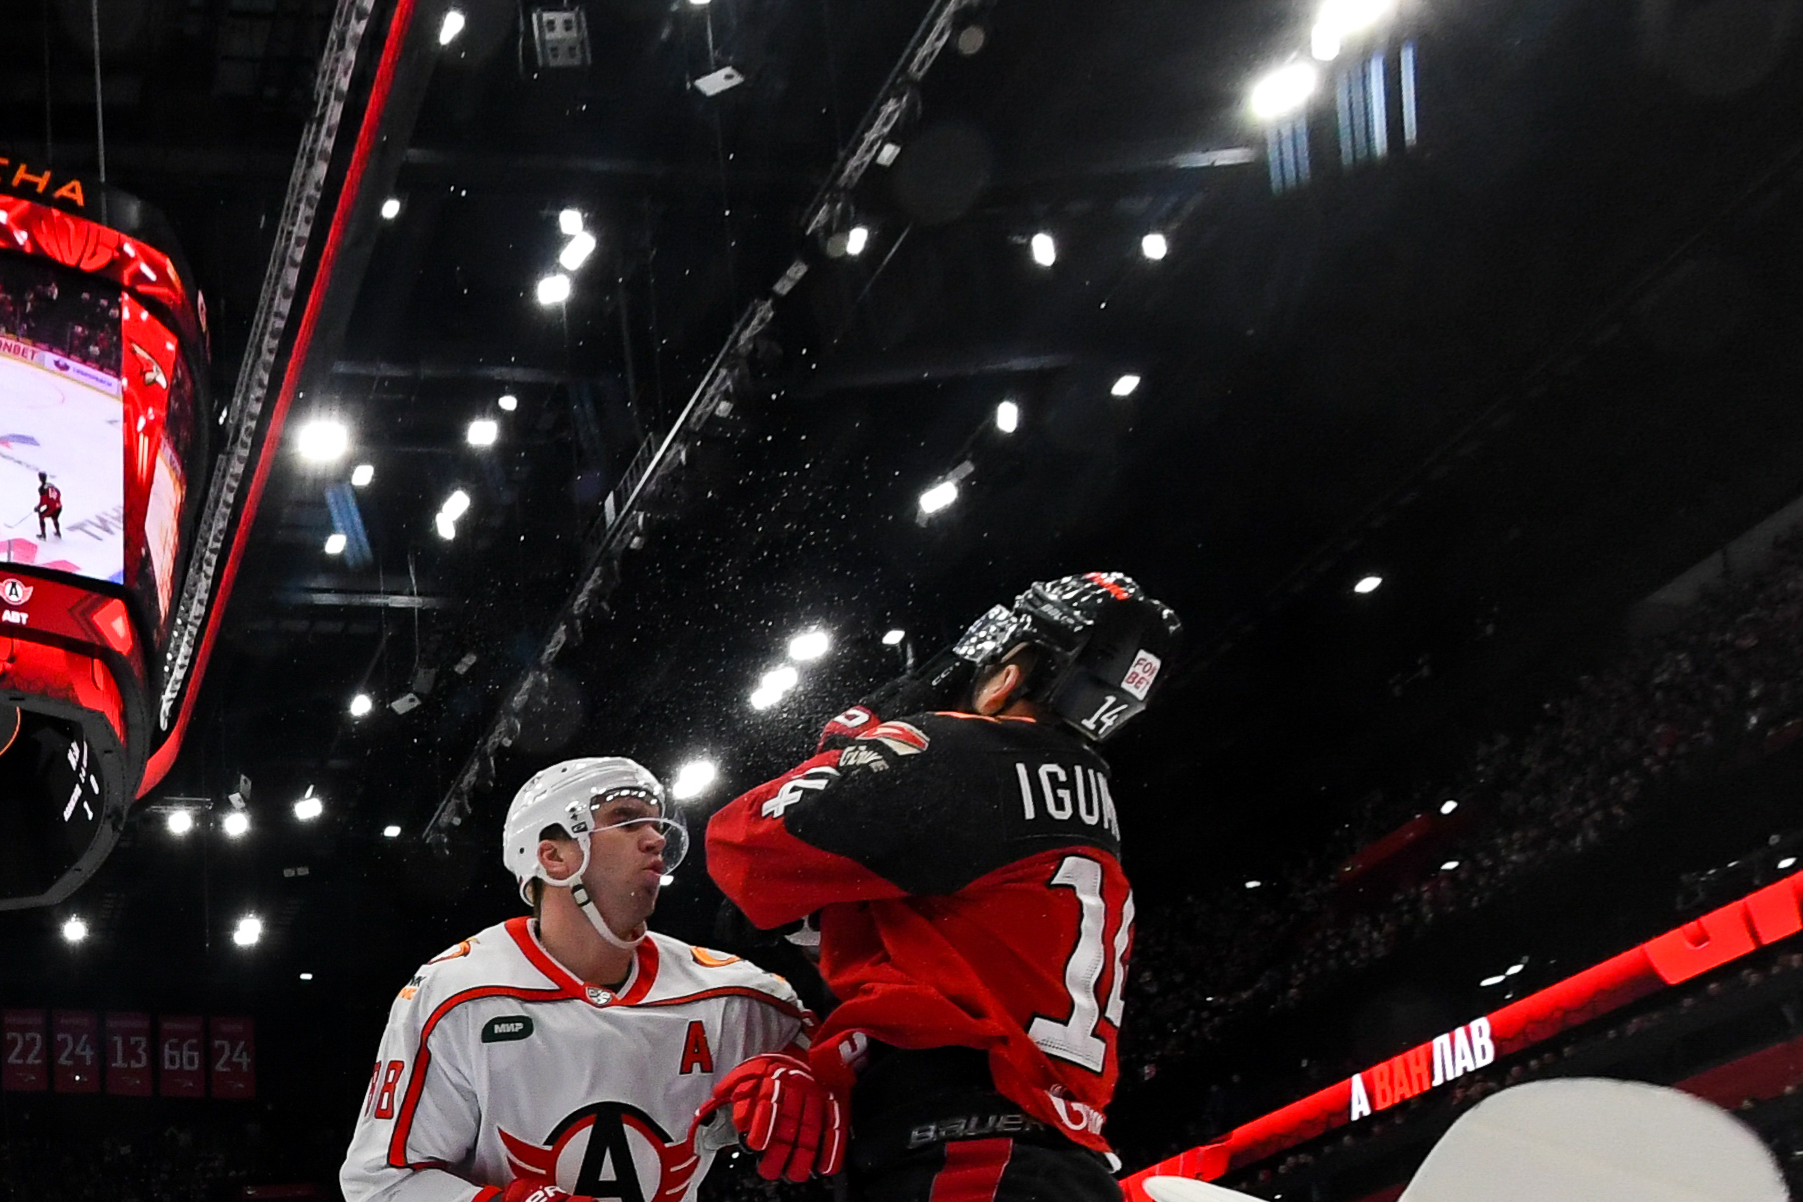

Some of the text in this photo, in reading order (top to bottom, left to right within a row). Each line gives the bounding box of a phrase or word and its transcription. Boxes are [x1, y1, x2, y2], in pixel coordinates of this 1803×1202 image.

[1, 609, 29, 626] АВТ
[1080, 695, 1129, 736] 14
[493, 1022, 525, 1035] МИР
[6, 1031, 43, 1065] 22
[56, 1032, 95, 1067] 24
[110, 1035, 148, 1069] 13
[163, 1037, 200, 1072] 66
[212, 1039, 252, 1073] 24
[680, 1020, 713, 1074] A
[1350, 1016, 1496, 1121] А ВАН ЛАВ
